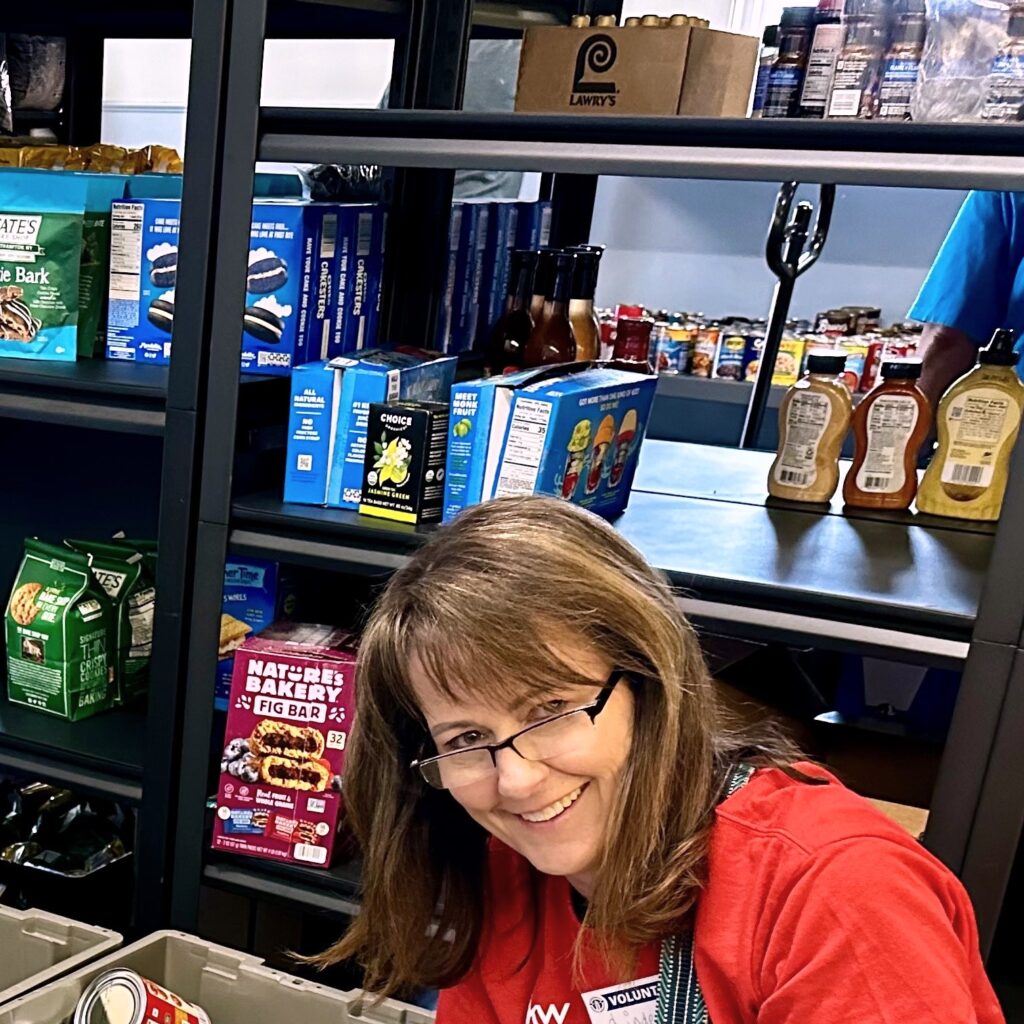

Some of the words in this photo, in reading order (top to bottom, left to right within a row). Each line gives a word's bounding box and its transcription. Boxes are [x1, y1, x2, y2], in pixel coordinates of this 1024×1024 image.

[569, 94, 616, 107] LAWRY'S
[15, 265, 51, 285] Bark
[339, 273, 347, 291] CAKE
[353, 259, 365, 316] CAKESTERS
[316, 261, 329, 319] CAKESTERS
[301, 293, 309, 308] AND
[338, 291, 346, 307] AND
[303, 388, 317, 396] ALL
[454, 392, 478, 401] MEET
[294, 395, 326, 404] NATURAL
[452, 400, 478, 409] MONK
[452, 407, 477, 417] FRUIT
[516, 404, 536, 413] Nutrition
[537, 407, 550, 415] Facts
[380, 413, 413, 426] CHOICE
[537, 426, 546, 434] 35
[368, 488, 391, 497] JASMINE
[391, 491, 410, 500] GREEN
[79, 653, 108, 673] CRISPY
[245, 676, 343, 703] BAKERY
[259, 700, 283, 716] FIG
[287, 703, 320, 720] BAR
[329, 733, 343, 745] 32
[607, 985, 658, 1006] VOLUNT
